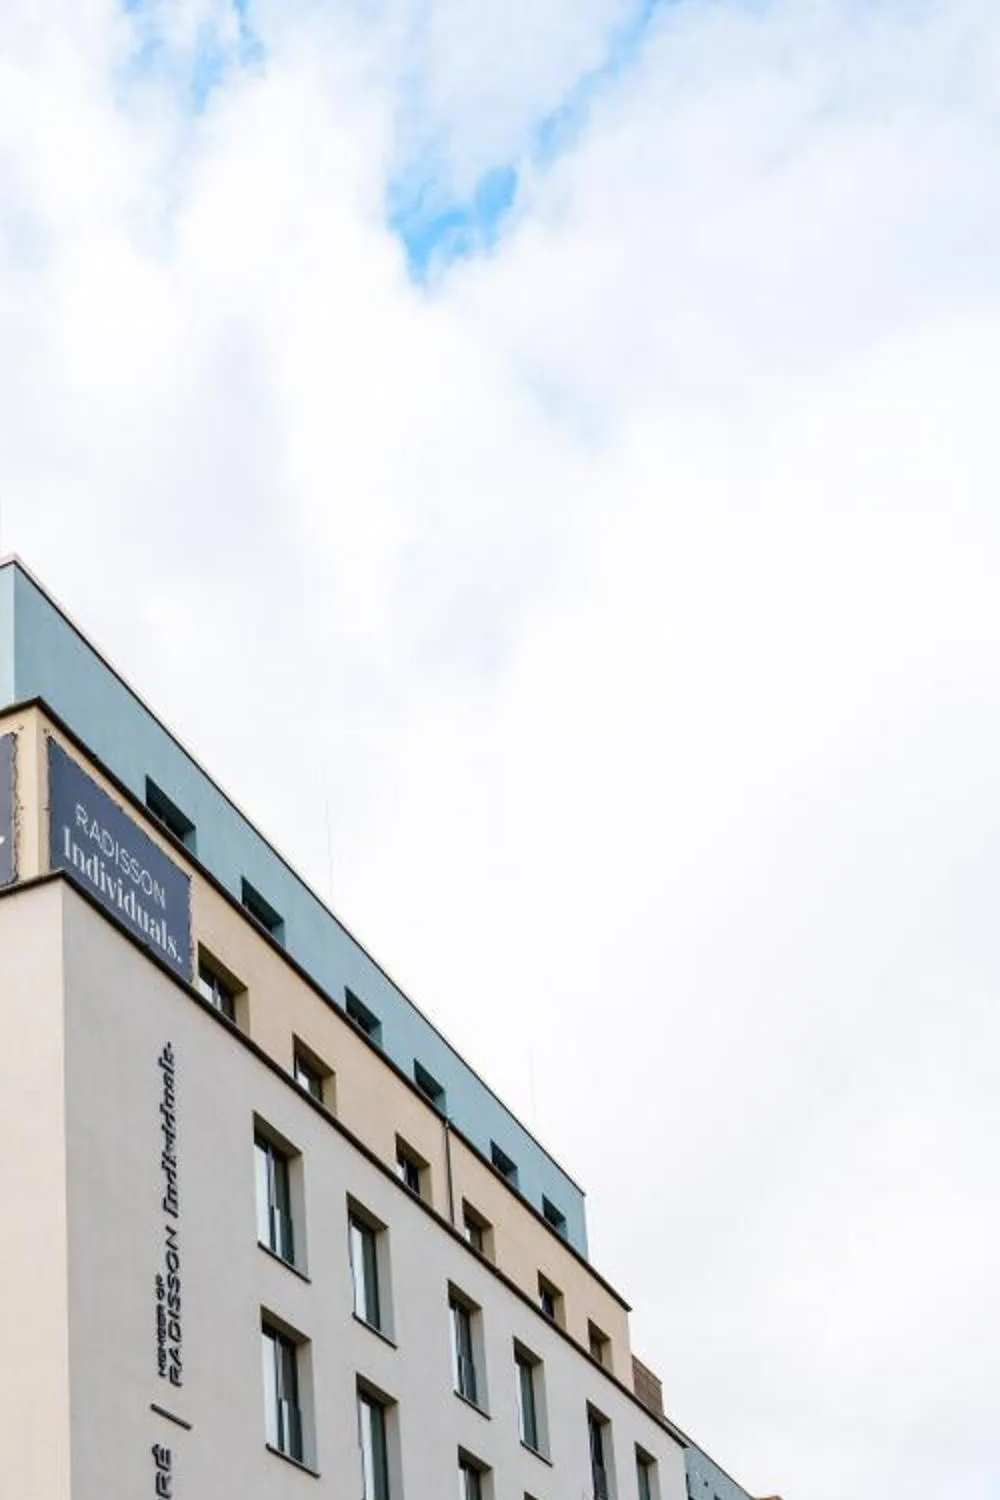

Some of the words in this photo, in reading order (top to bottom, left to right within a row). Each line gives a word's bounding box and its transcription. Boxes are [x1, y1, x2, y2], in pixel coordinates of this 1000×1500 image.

[61, 824, 184, 964] Individuals.
[72, 800, 167, 911] RADISSON
[164, 1225, 184, 1388] RADISSON
